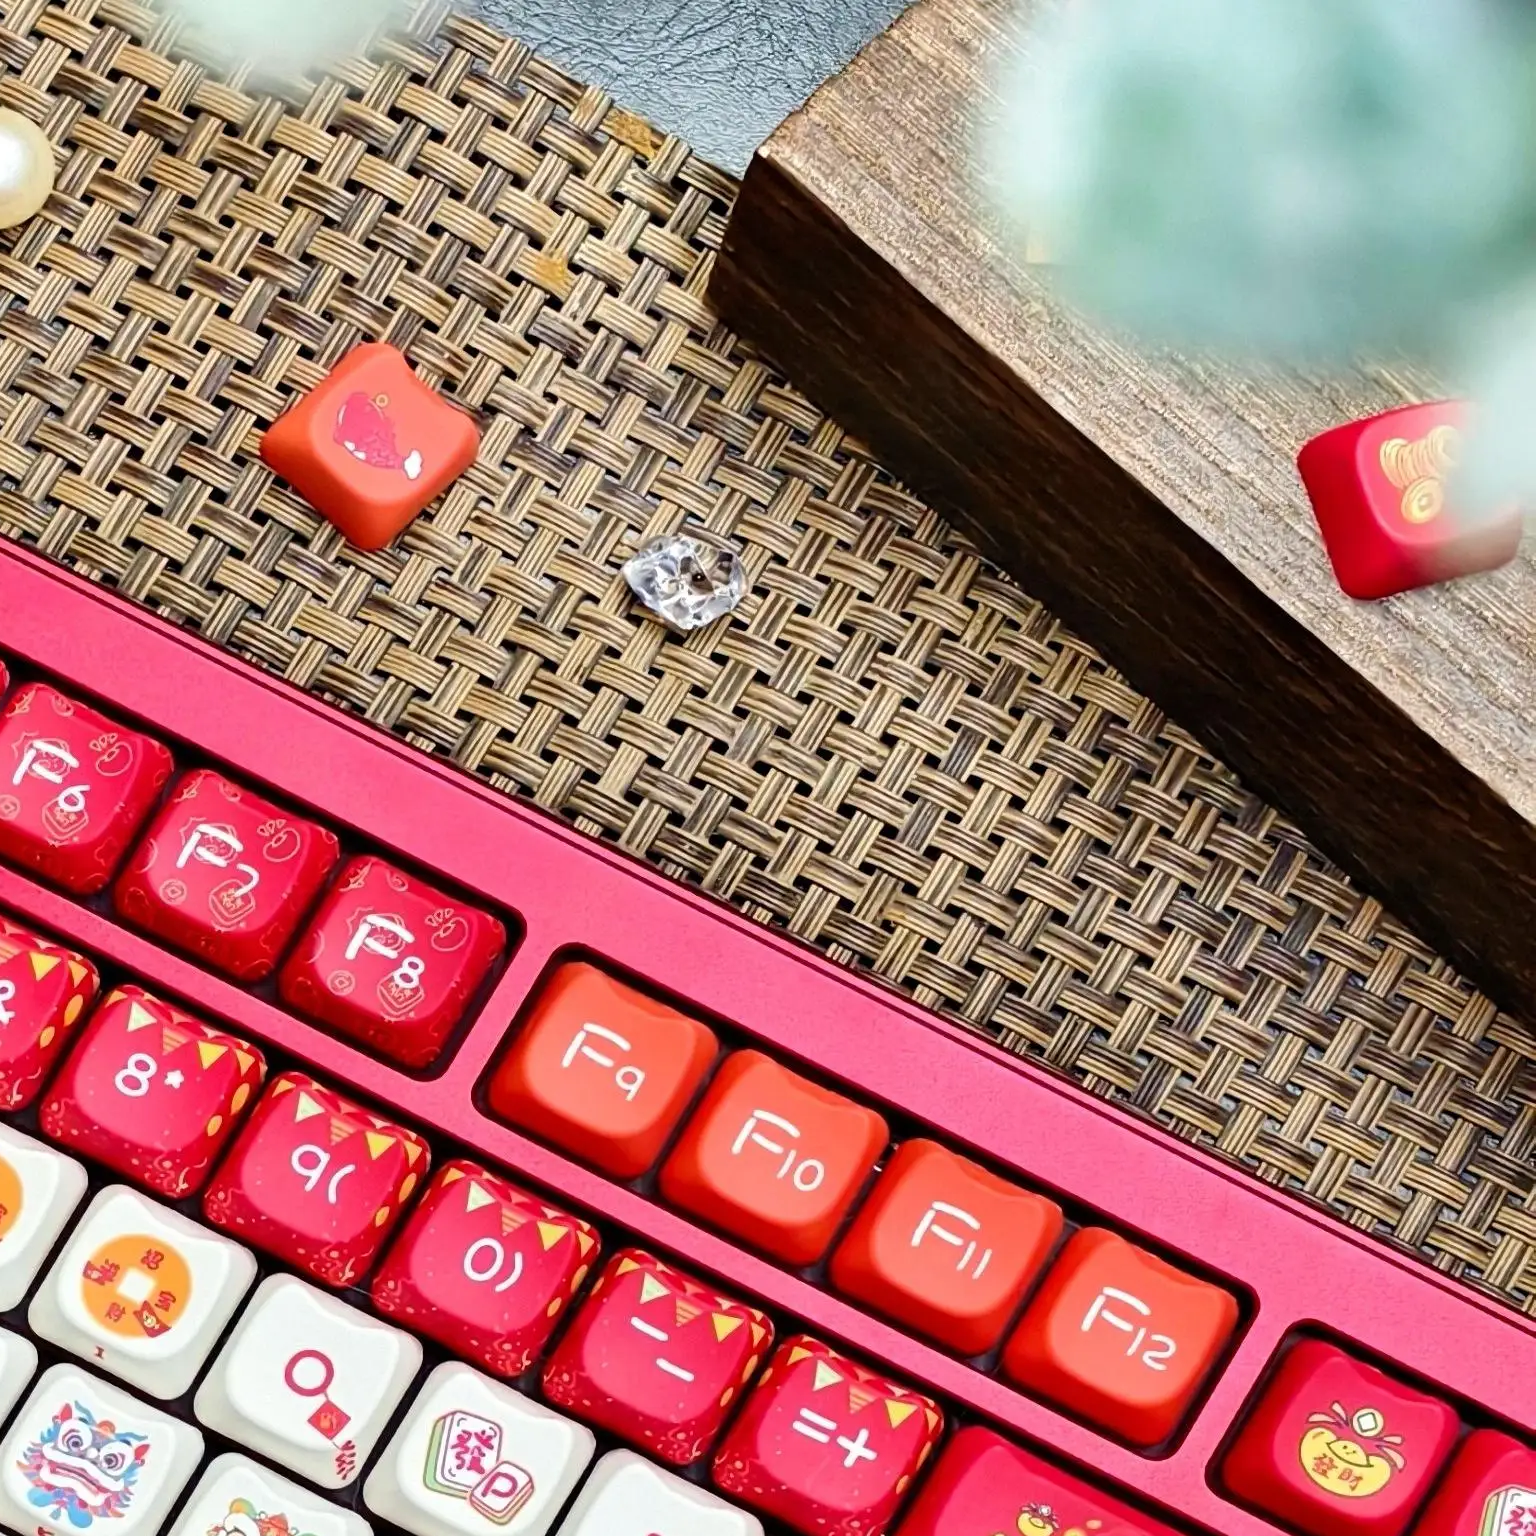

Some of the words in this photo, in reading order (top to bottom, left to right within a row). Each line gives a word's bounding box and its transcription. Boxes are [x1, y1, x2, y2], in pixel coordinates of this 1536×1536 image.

[13, 741, 86, 814] F6
[176, 824, 259, 898] F7
[345, 912, 424, 989] F8
[561, 1024, 645, 1101] F9
[731, 1109, 824, 1191] F10
[910, 1202, 992, 1280] F11
[1080, 1286, 1176, 1371] F12
[285, 1350, 334, 1397] O
[484, 1471, 518, 1498] P
